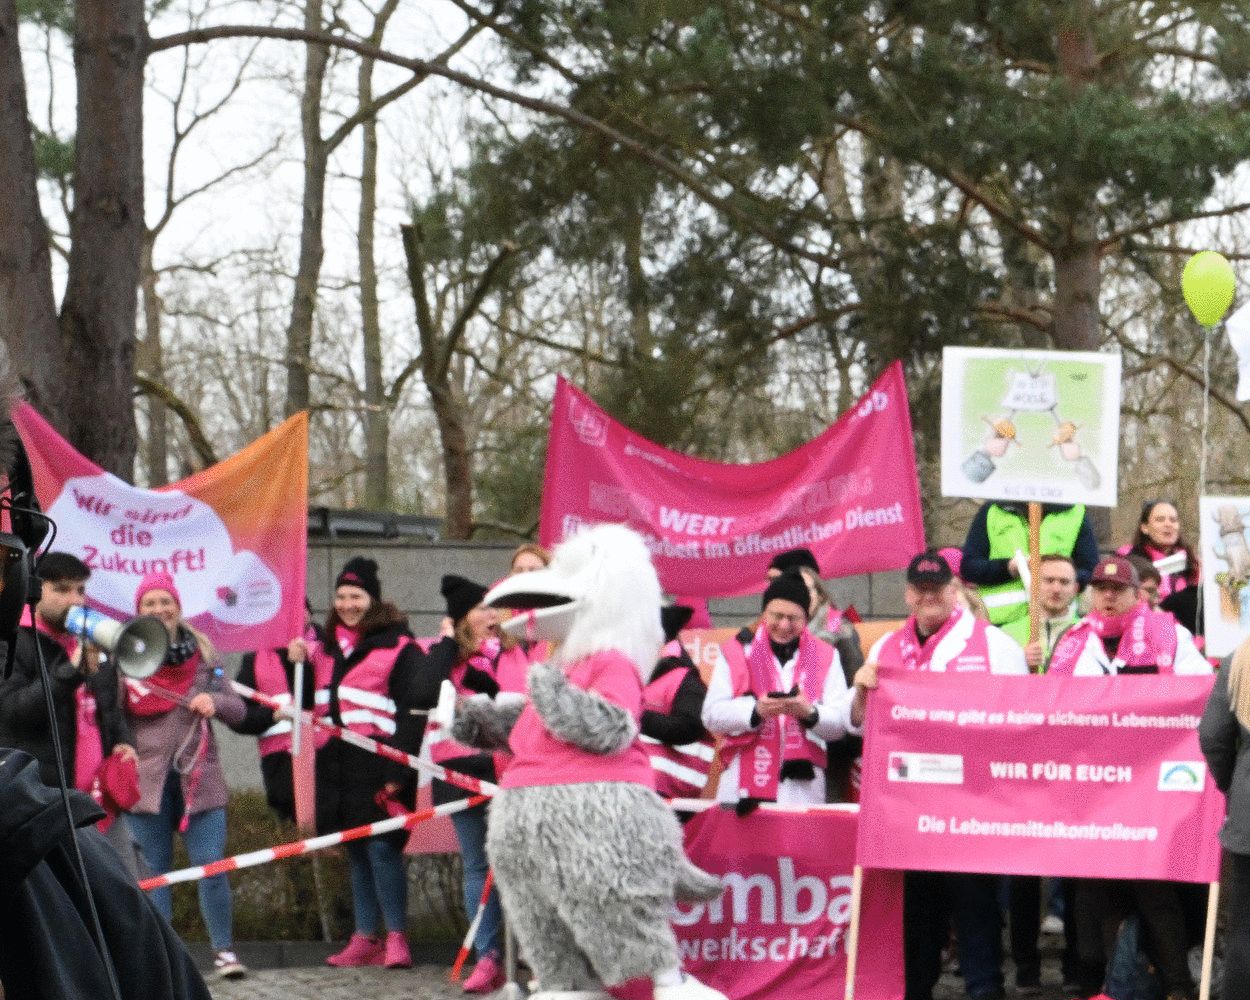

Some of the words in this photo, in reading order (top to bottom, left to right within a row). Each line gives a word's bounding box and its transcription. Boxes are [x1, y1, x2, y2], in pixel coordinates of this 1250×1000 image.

[110, 524, 153, 548] die
[733, 517, 843, 556] öffentlichen
[845, 502, 904, 531] Dienst
[82, 545, 206, 575] Zukunft!
[1047, 710, 1110, 728] sicheren
[990, 761, 1028, 780] WIR
[1032, 760, 1072, 781] FÜR
[1076, 764, 1132, 783] EUCH
[917, 814, 946, 834] Die
[949, 816, 1158, 842] Lebensmittelkontrolleure
